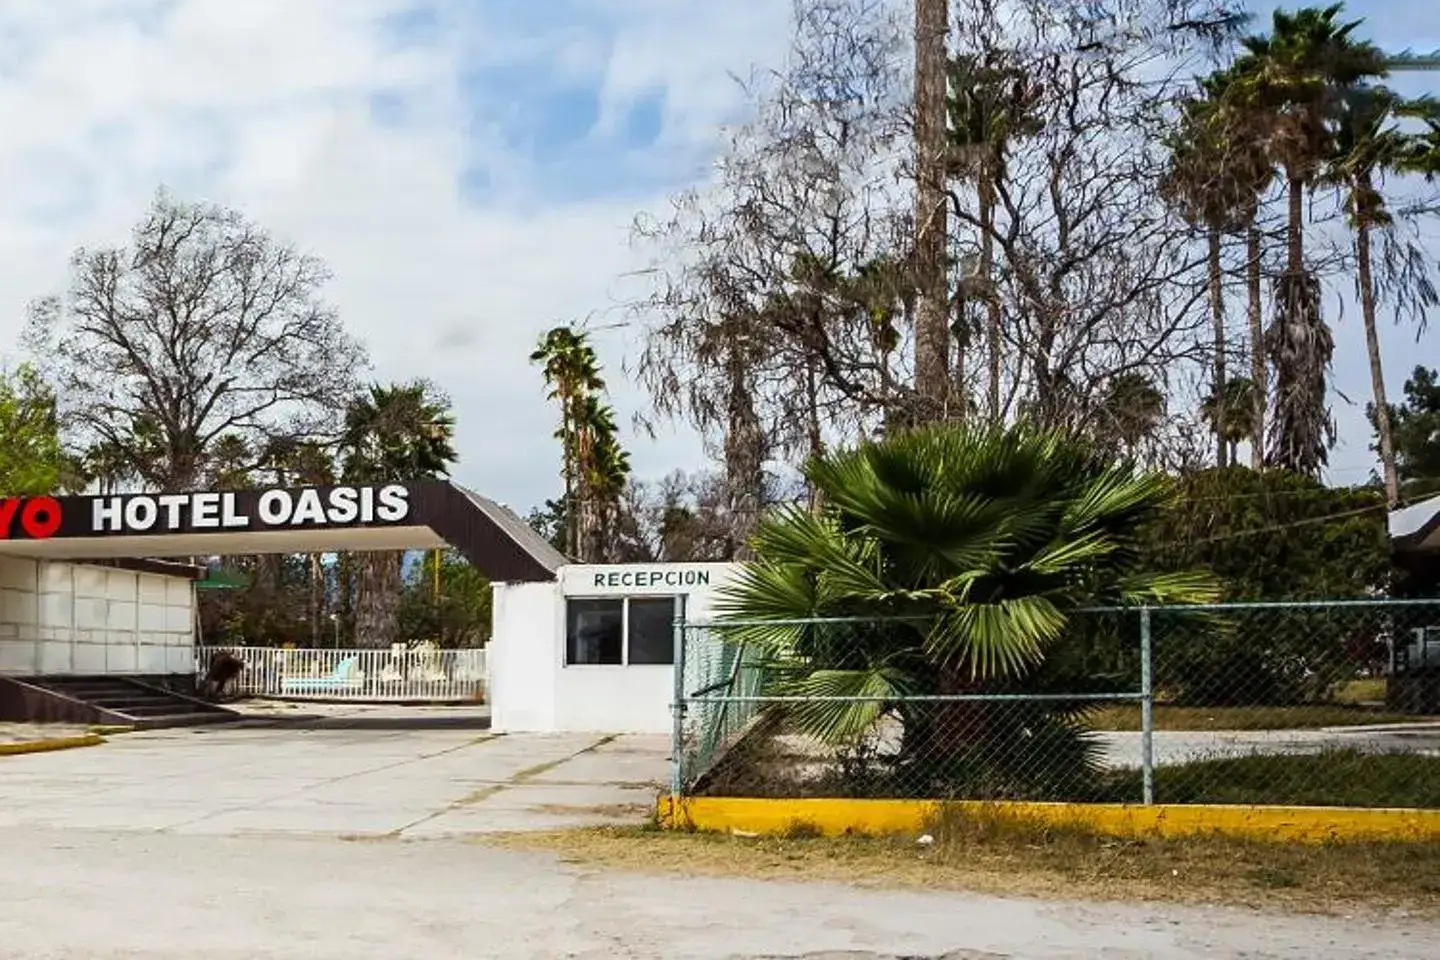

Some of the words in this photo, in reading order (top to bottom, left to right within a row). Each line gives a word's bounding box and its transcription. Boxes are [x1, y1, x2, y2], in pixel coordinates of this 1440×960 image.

[92, 493, 249, 531] HOTEL
[259, 485, 409, 524] OASIS
[594, 570, 710, 587] RECEPCION
